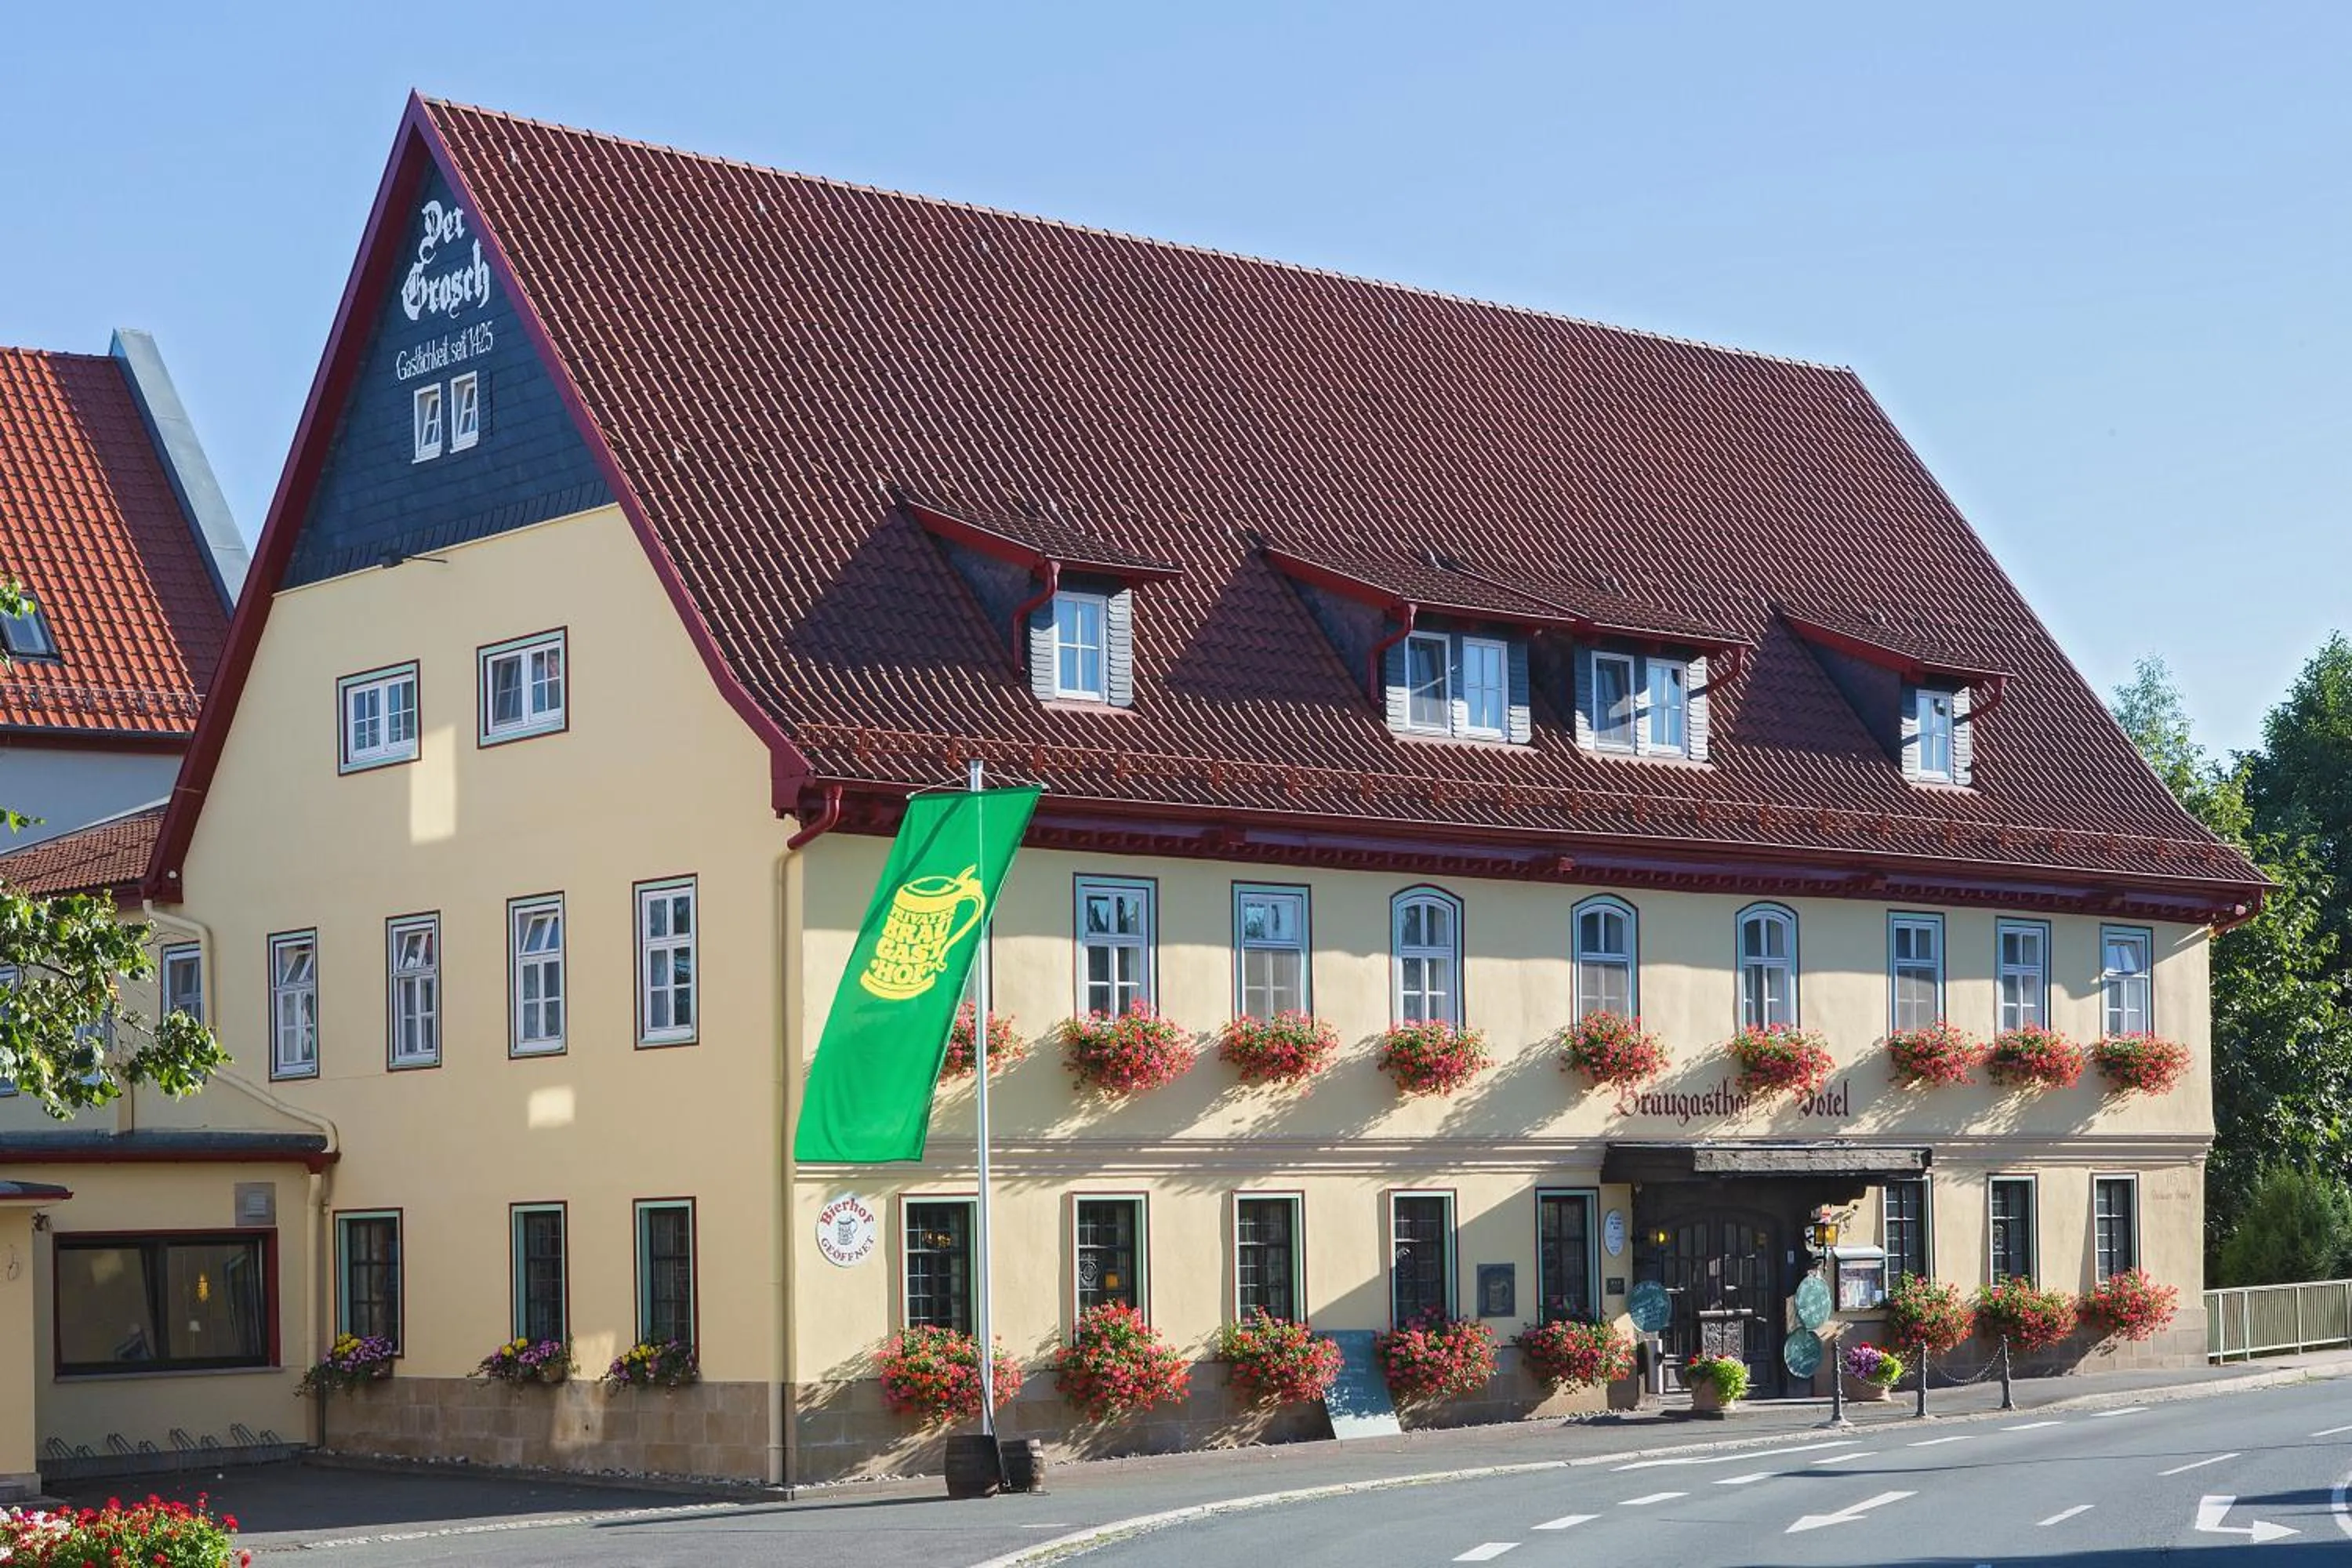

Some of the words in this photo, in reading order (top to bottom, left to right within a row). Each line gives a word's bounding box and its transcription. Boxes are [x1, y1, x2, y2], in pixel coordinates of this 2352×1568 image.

[419, 200, 465, 264] Der
[401, 238, 490, 321] Grosch
[451, 328, 468, 363] seit
[467, 321, 493, 357] 1425
[882, 915, 953, 945] BRAU
[877, 936, 944, 964] GAST
[820, 1197, 874, 1225] Bierhof
